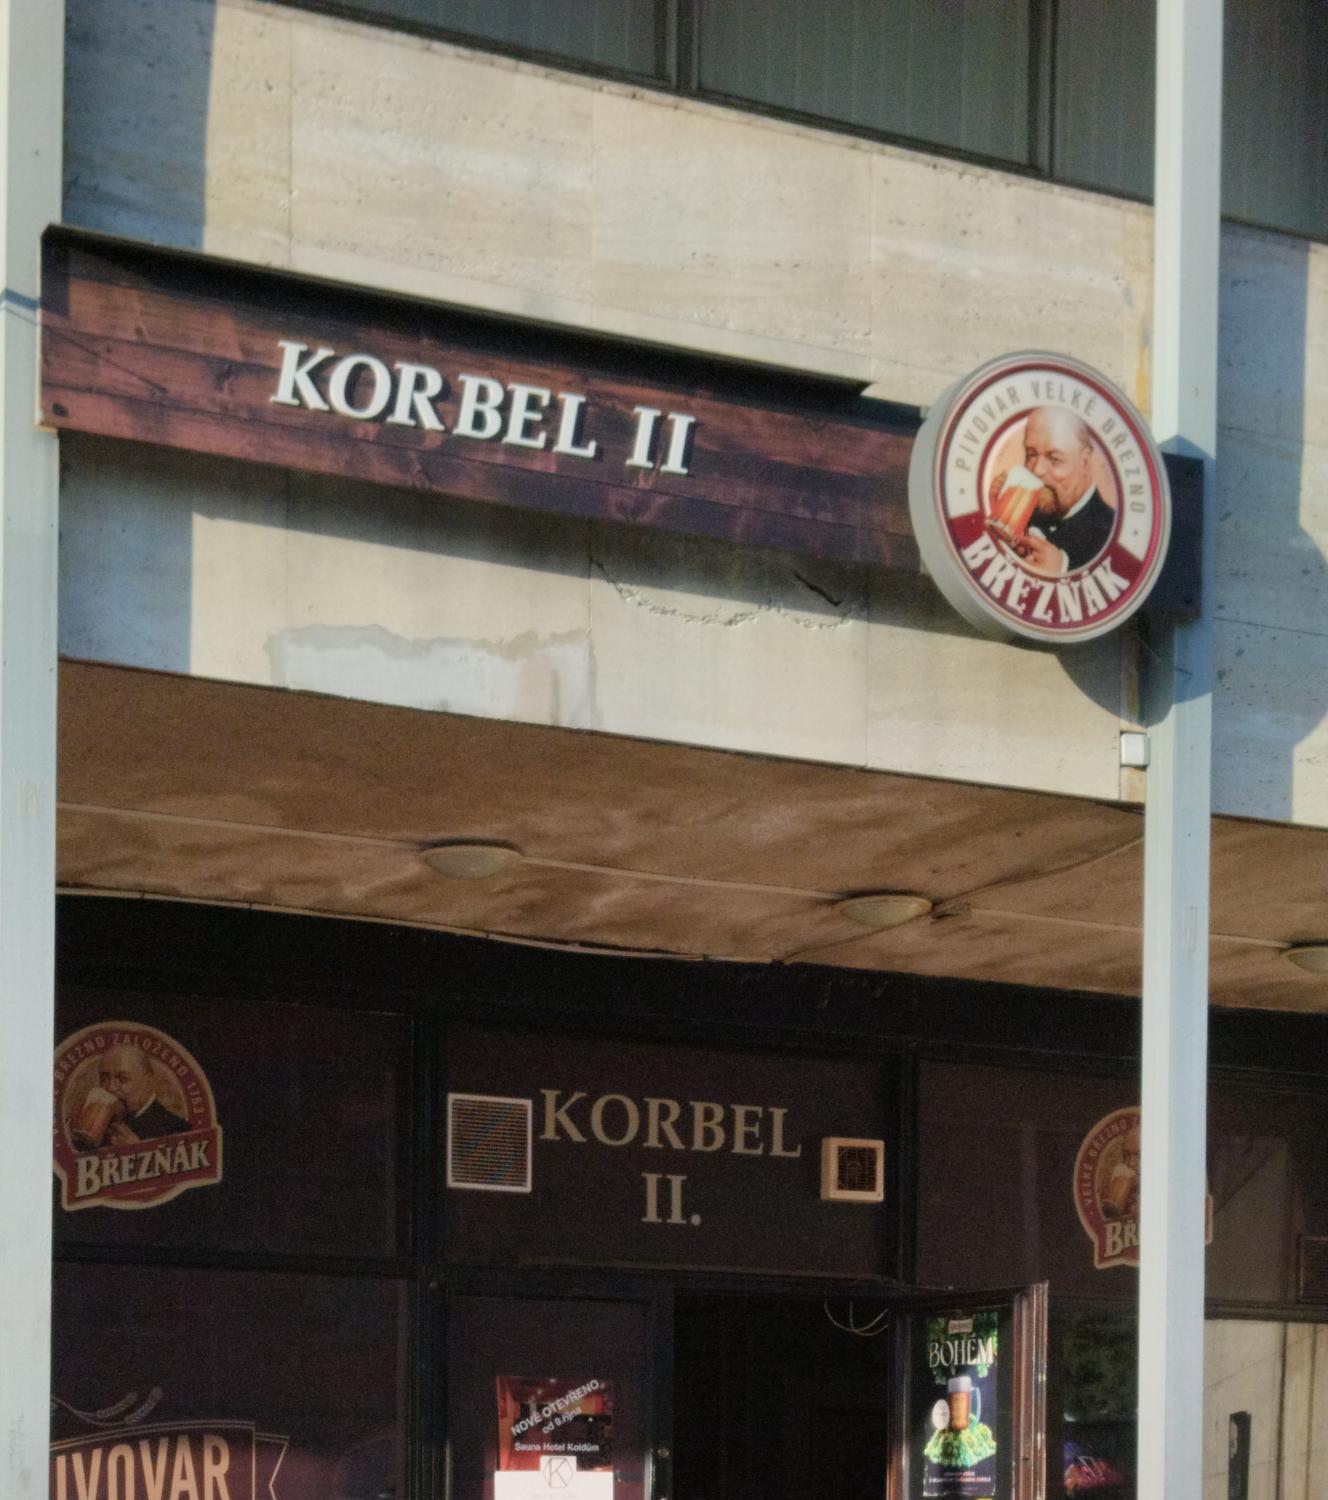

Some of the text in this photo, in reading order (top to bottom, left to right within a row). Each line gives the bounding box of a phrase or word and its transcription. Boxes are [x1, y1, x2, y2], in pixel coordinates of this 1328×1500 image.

[269, 339, 697, 476] KORBEL II
[955, 380, 1146, 514] PIVOVAR VELKÉ BŘEZNO
[960, 531, 1131, 624] BŘEZŇÁK
[539, 1089, 802, 1158] KORBEL
[75, 1139, 211, 1198] BŘEZŇÁK
[641, 1172, 702, 1226] II.
[929, 1333, 994, 1369] BOHÉM
[514, 1441, 541, 1452] Sauna
[543, 1442, 566, 1452] Hotel
